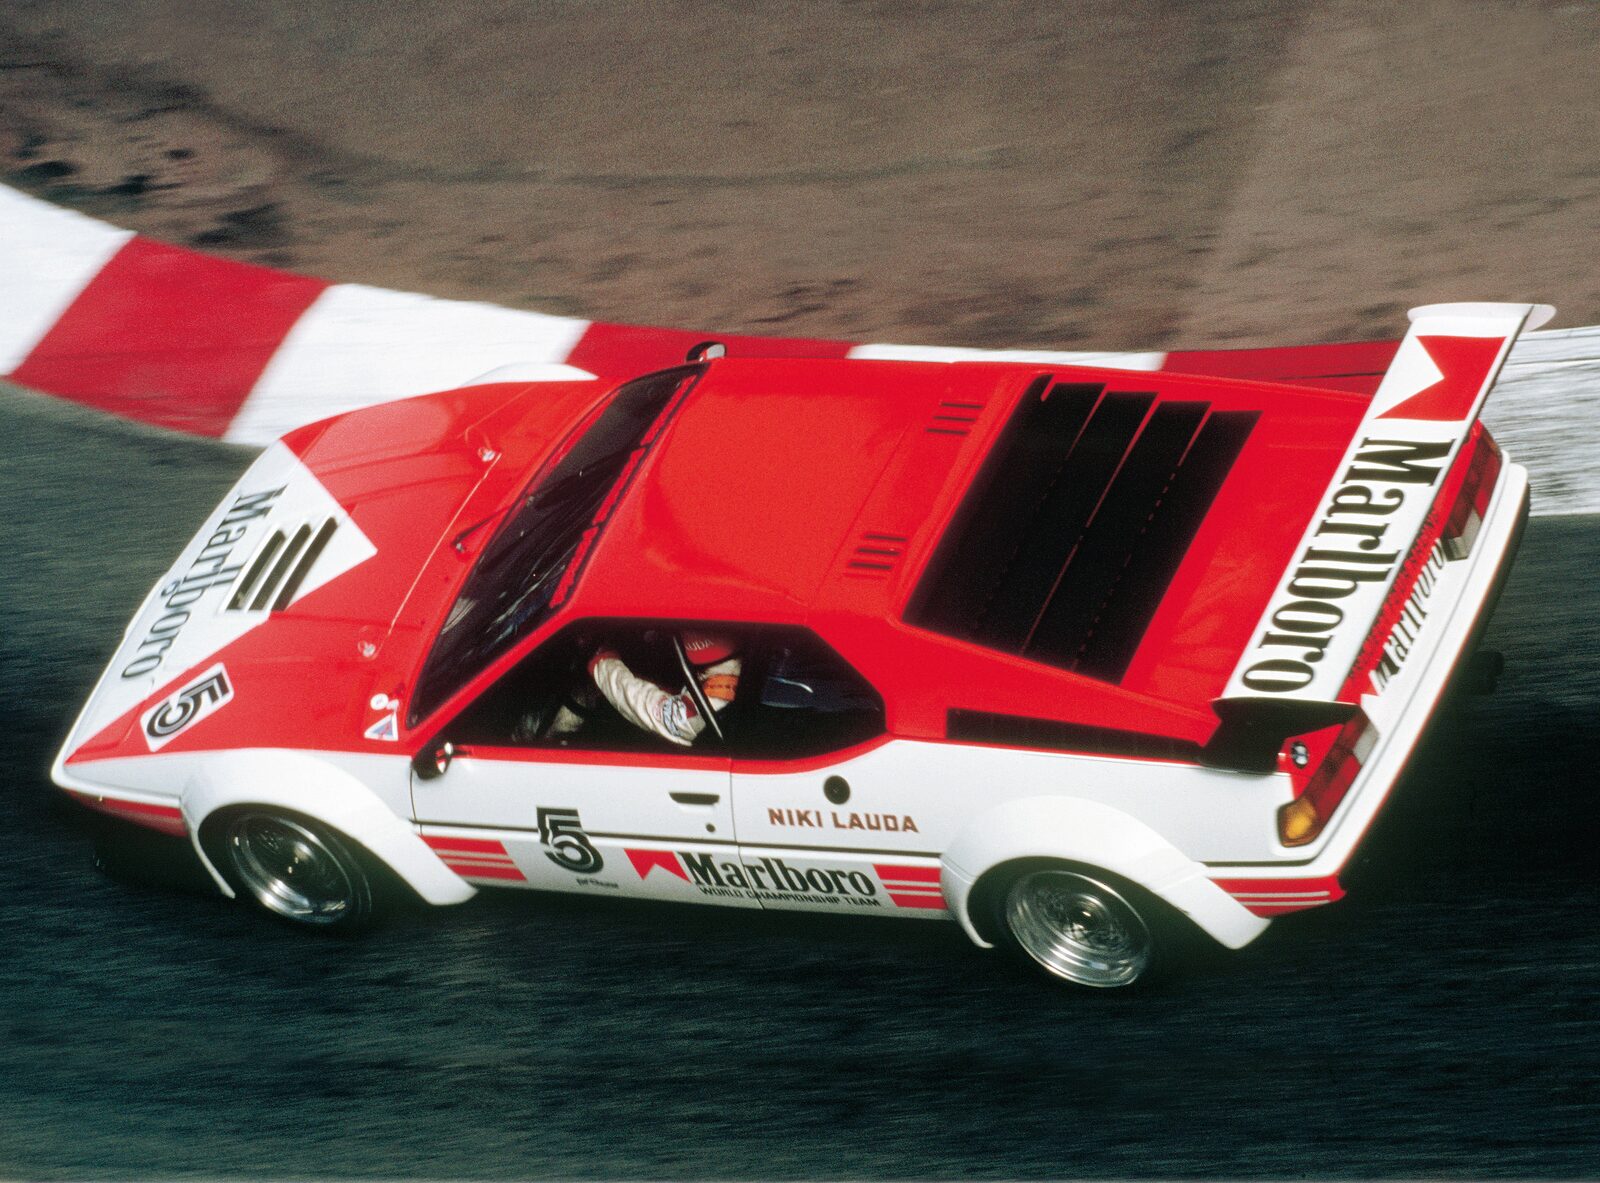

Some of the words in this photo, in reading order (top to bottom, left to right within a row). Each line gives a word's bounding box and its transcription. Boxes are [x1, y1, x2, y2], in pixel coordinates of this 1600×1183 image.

[121, 483, 289, 679] Marlboro
[1242, 437, 1456, 693] Marlboro
[146, 671, 231, 737] 5
[536, 806, 604, 874] 5
[767, 808, 823, 828] NIKI
[831, 812, 920, 833] LAUDA
[677, 851, 876, 897] Marlboro
[700, 887, 744, 898] WORLD
[746, 890, 841, 905] CHAMPIONSHIP
[843, 896, 882, 907] TEAM
